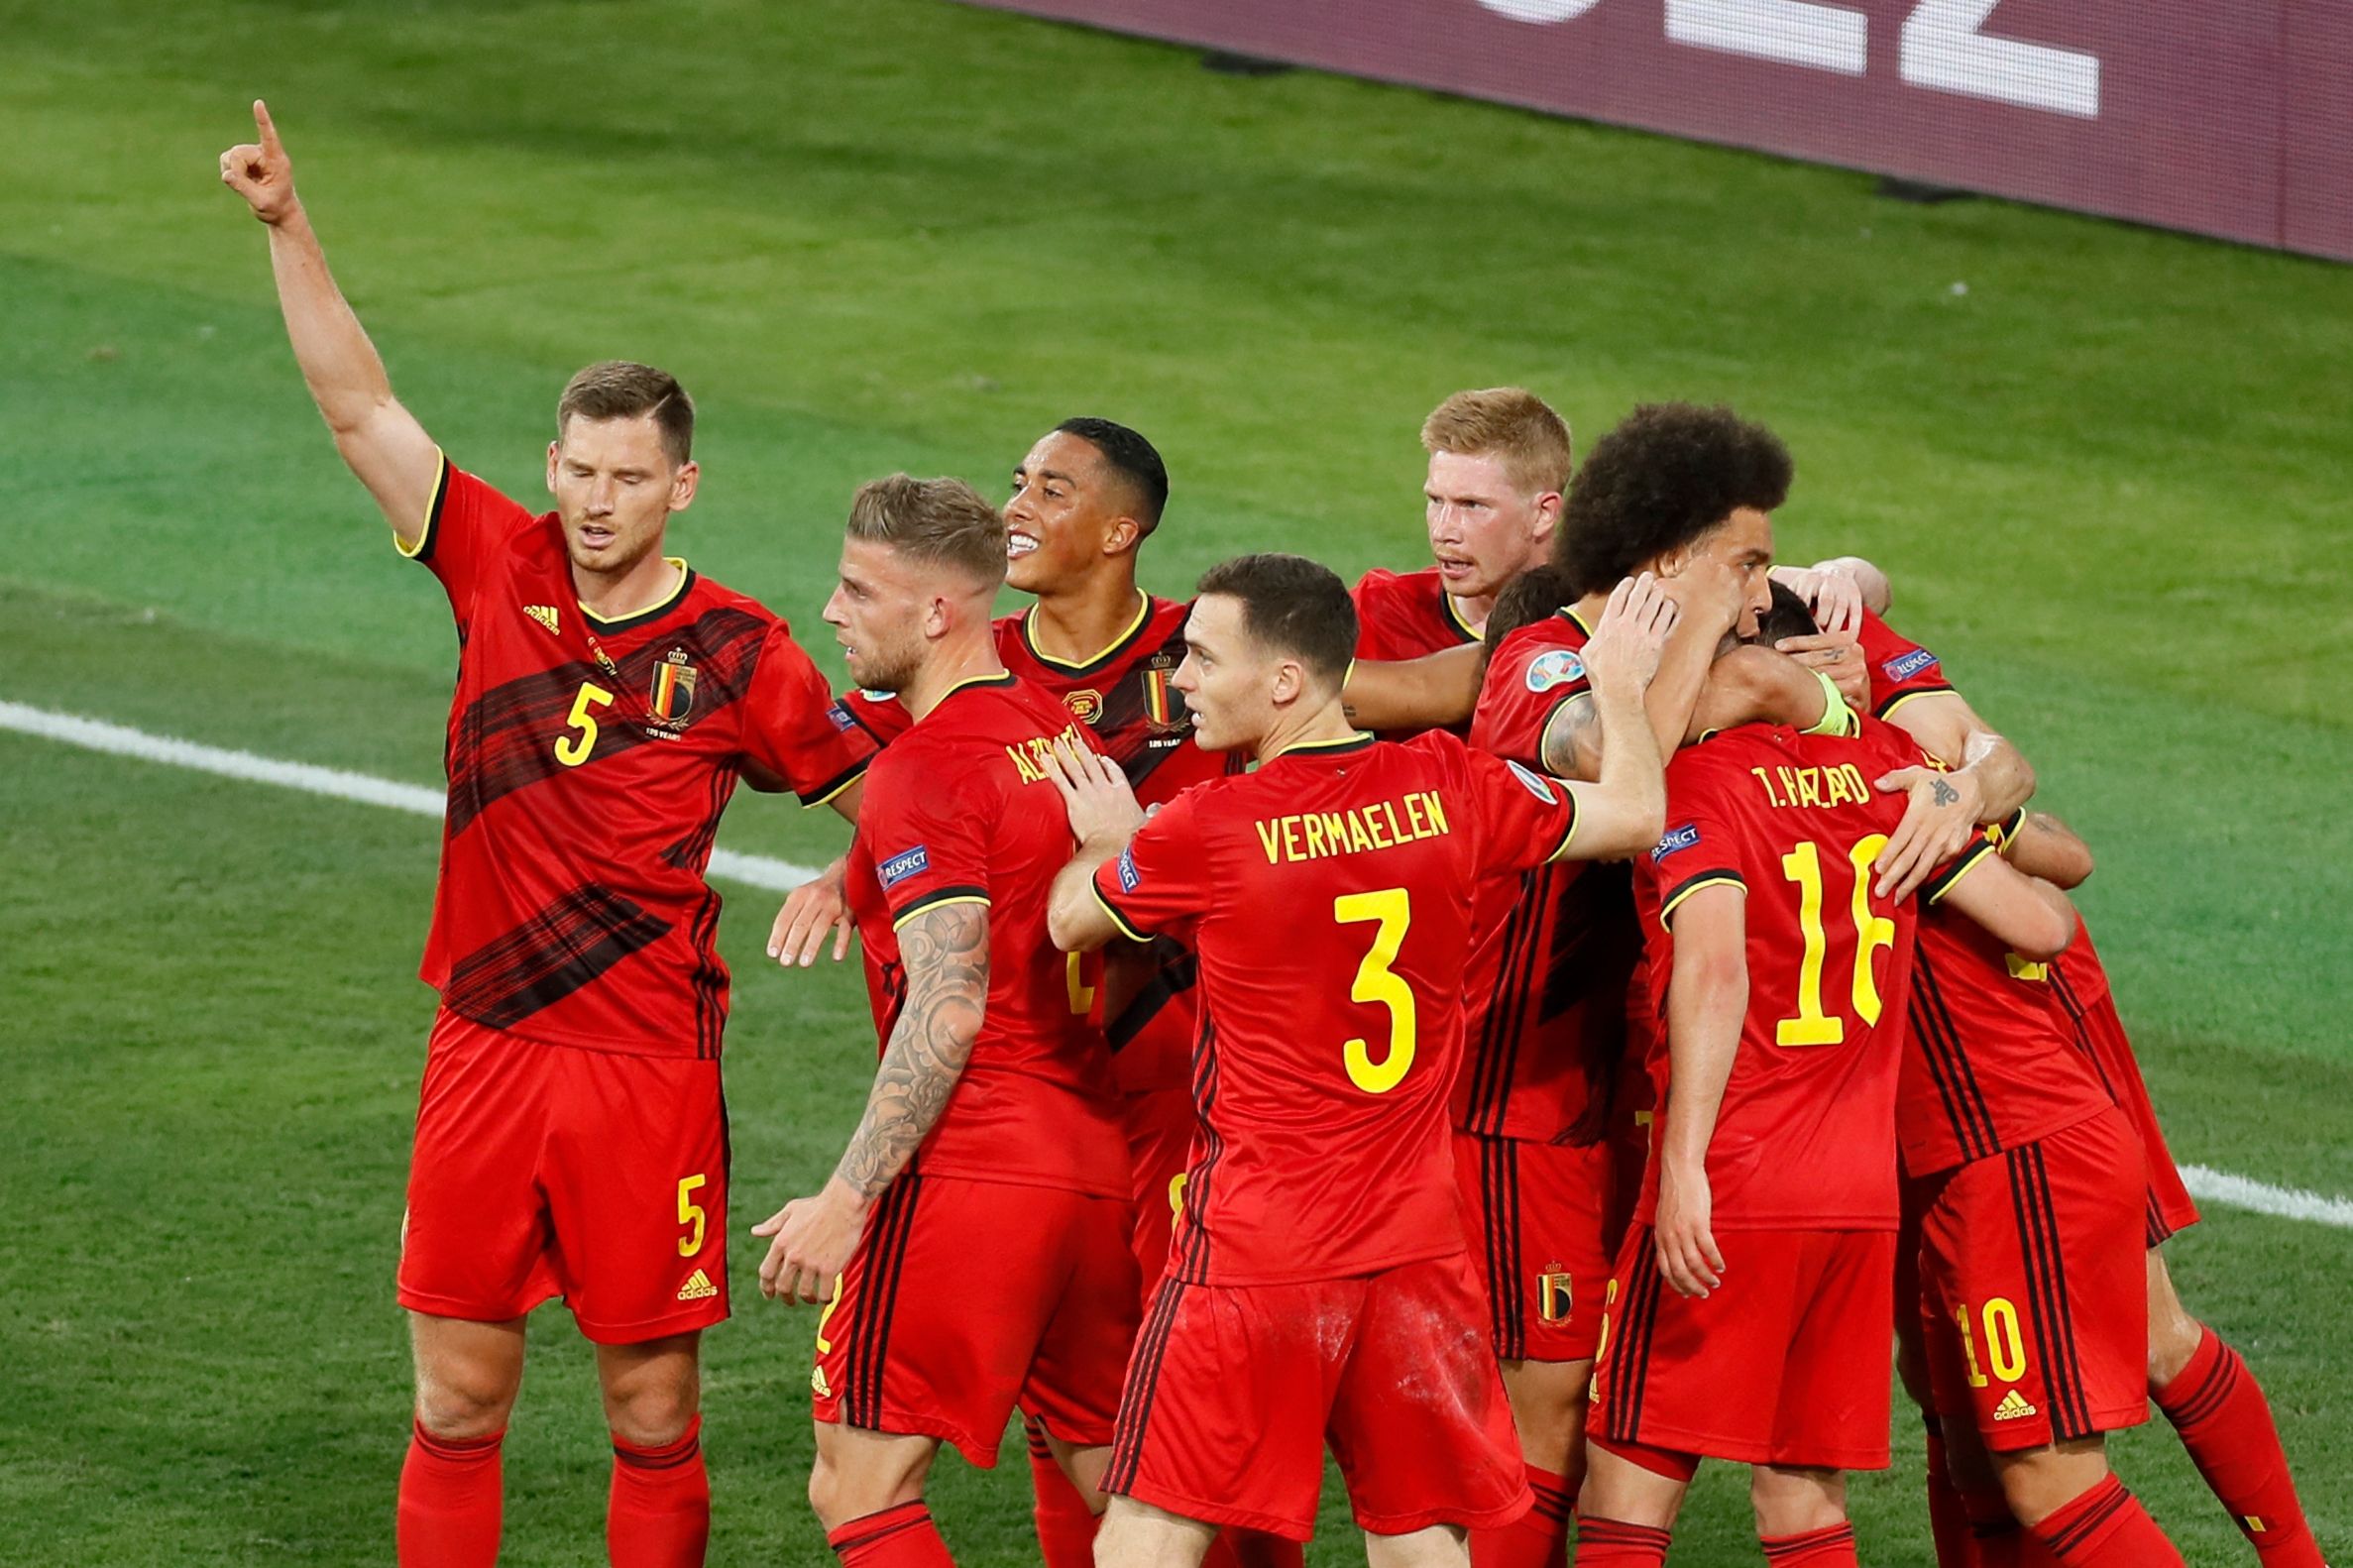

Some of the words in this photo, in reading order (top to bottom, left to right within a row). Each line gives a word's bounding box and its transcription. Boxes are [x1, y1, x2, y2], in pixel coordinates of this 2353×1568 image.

[554, 681, 615, 767] 5
[885, 851, 926, 879] RESPECT
[1255, 790, 1449, 864] VERMAELEN
[1334, 887, 1416, 1094] 3
[677, 1174, 706, 1257] 5
[677, 1286, 718, 1300] adidas
[1957, 1297, 2027, 1388] 10
[1993, 1404, 2037, 1421] adidas
